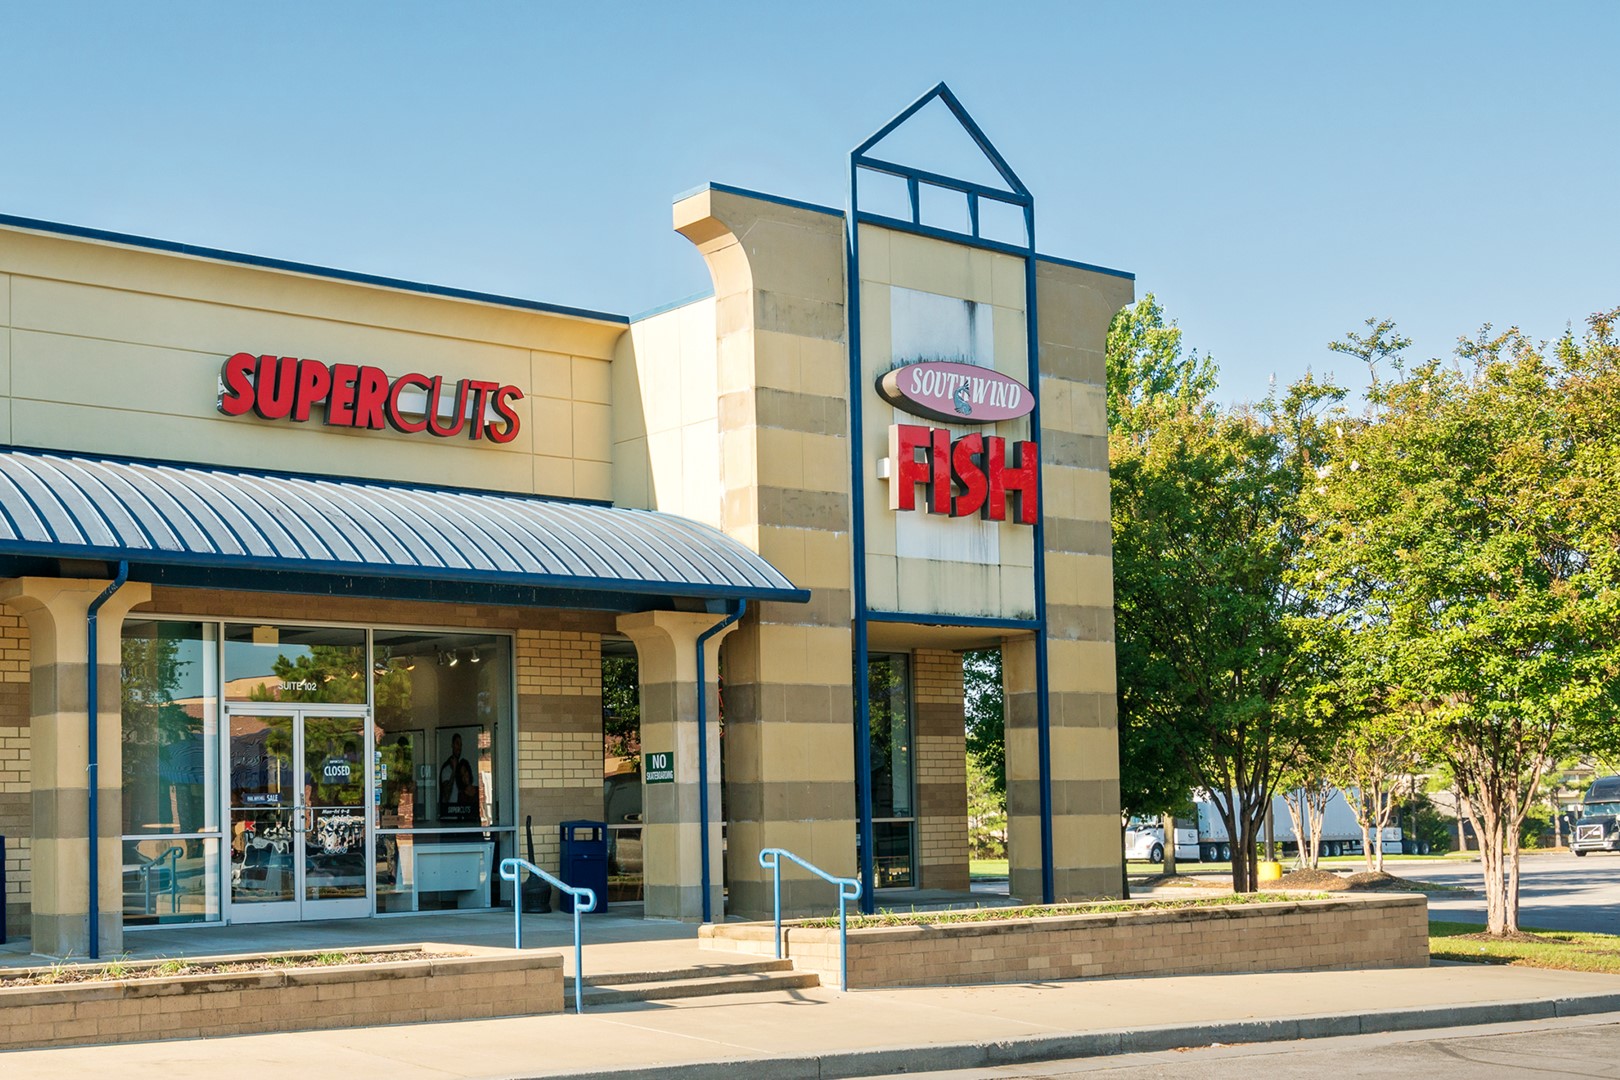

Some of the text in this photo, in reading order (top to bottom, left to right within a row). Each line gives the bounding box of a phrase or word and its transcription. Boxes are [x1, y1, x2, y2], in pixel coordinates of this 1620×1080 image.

[911, 367, 1022, 409] SOUTHWIND
[219, 352, 525, 444] SUPERCUTS
[892, 424, 1038, 525] FISH
[278, 681, 317, 691] SUITE 102
[652, 754, 667, 769] NO
[324, 765, 351, 777] CLOSED
[266, 794, 279, 802] SALE
